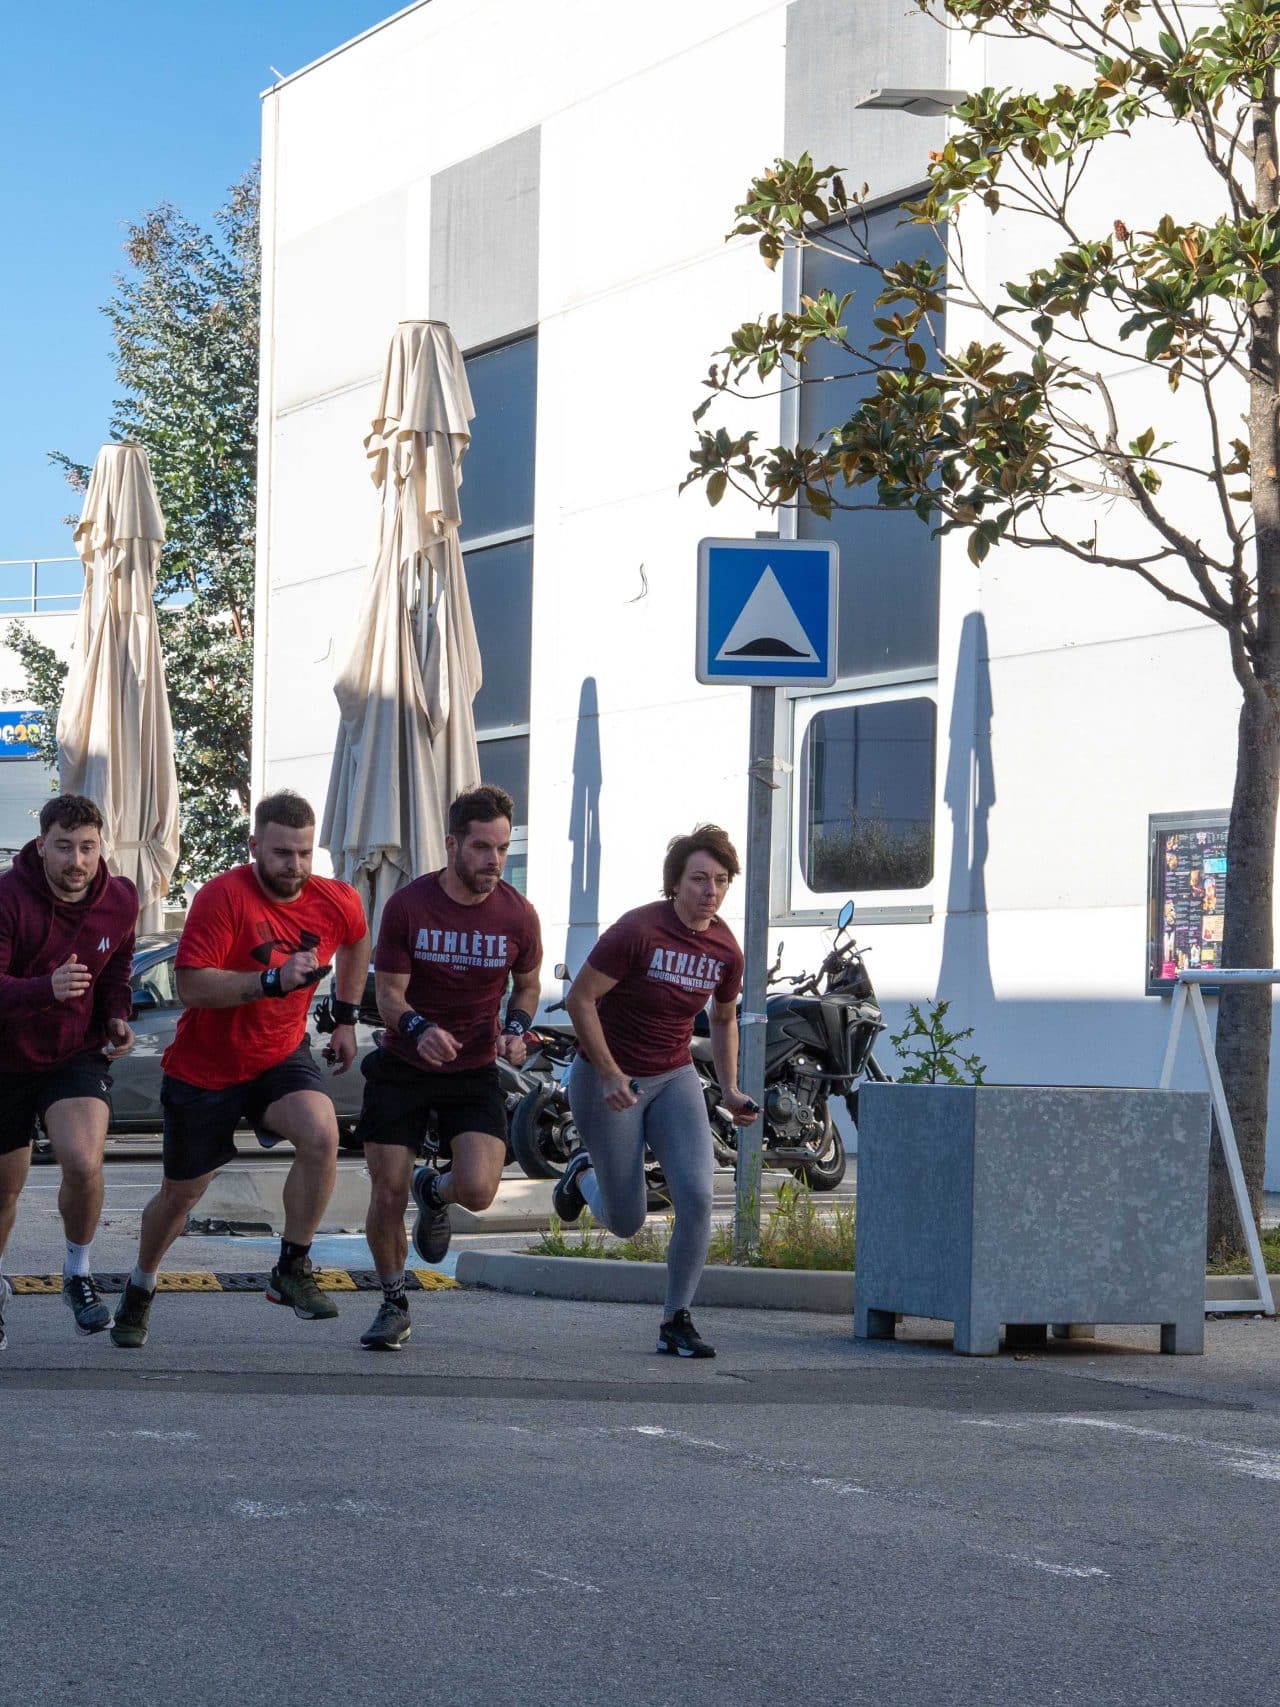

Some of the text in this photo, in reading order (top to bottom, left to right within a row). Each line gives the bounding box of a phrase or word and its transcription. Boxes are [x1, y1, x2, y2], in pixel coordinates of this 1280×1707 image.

[415, 927, 508, 957] ATHLÈTE
[414, 950, 507, 968] MOUGINS WINTER SHOW
[650, 948, 725, 981] ATHLÈTE
